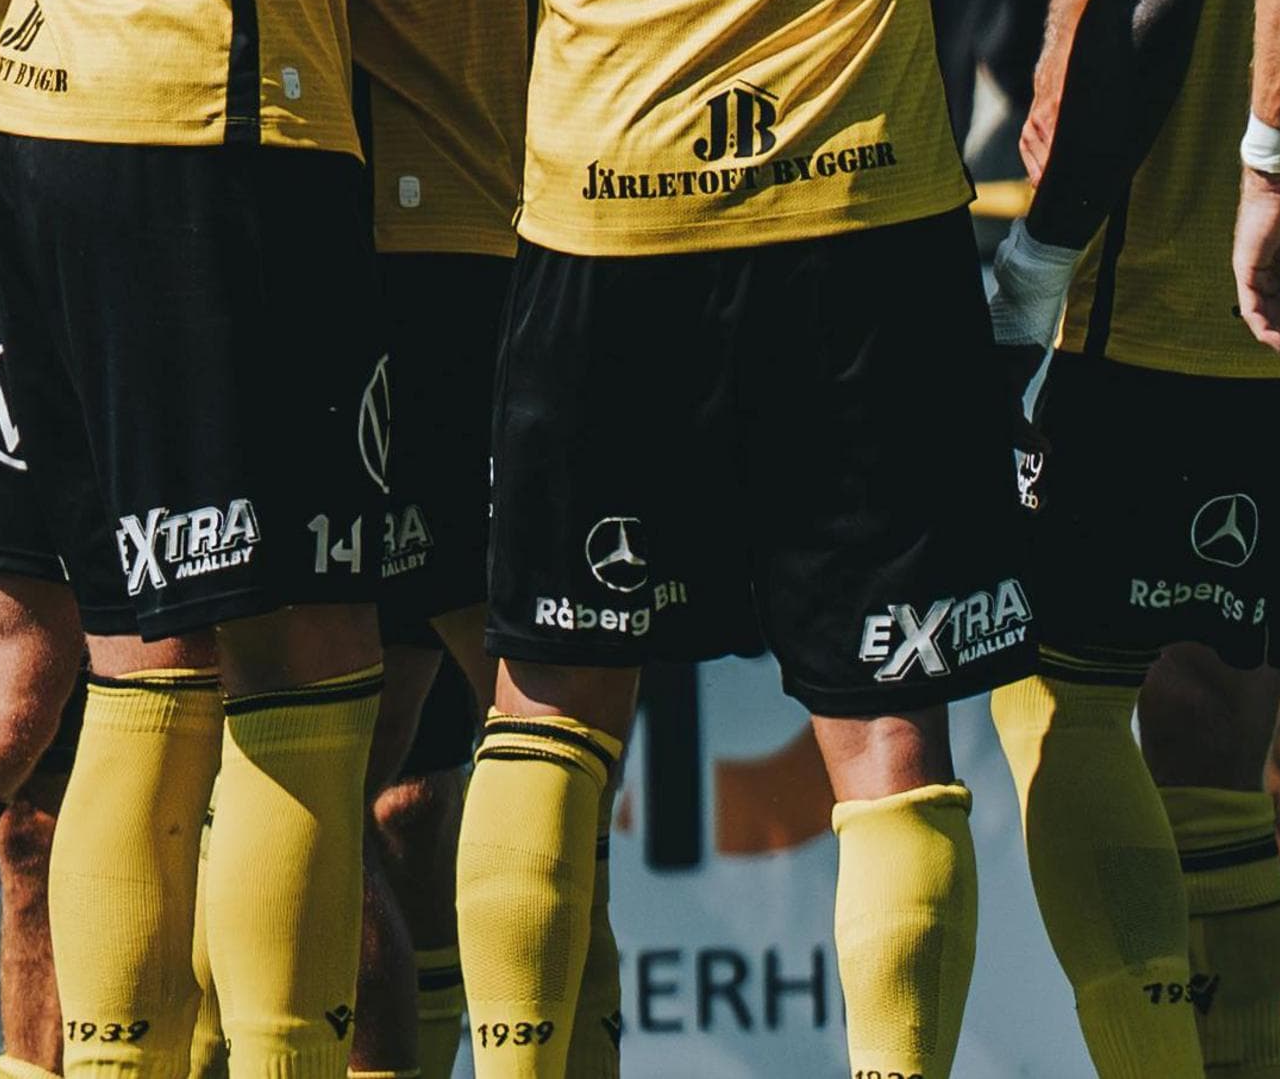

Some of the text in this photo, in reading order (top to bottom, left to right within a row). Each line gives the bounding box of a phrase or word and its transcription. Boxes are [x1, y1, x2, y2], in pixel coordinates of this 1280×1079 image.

[582, 141, 897, 201] JÄRLETOFT BYGGER
[116, 497, 262, 597] EXTRA
[175, 546, 254, 580] MJÄLLBY
[306, 513, 363, 574] 14
[858, 577, 1034, 683] EXTRA
[957, 625, 1028, 667] MJÄLLBY
[66, 1020, 151, 1044] 1939
[476, 1020, 556, 1050] 1939
